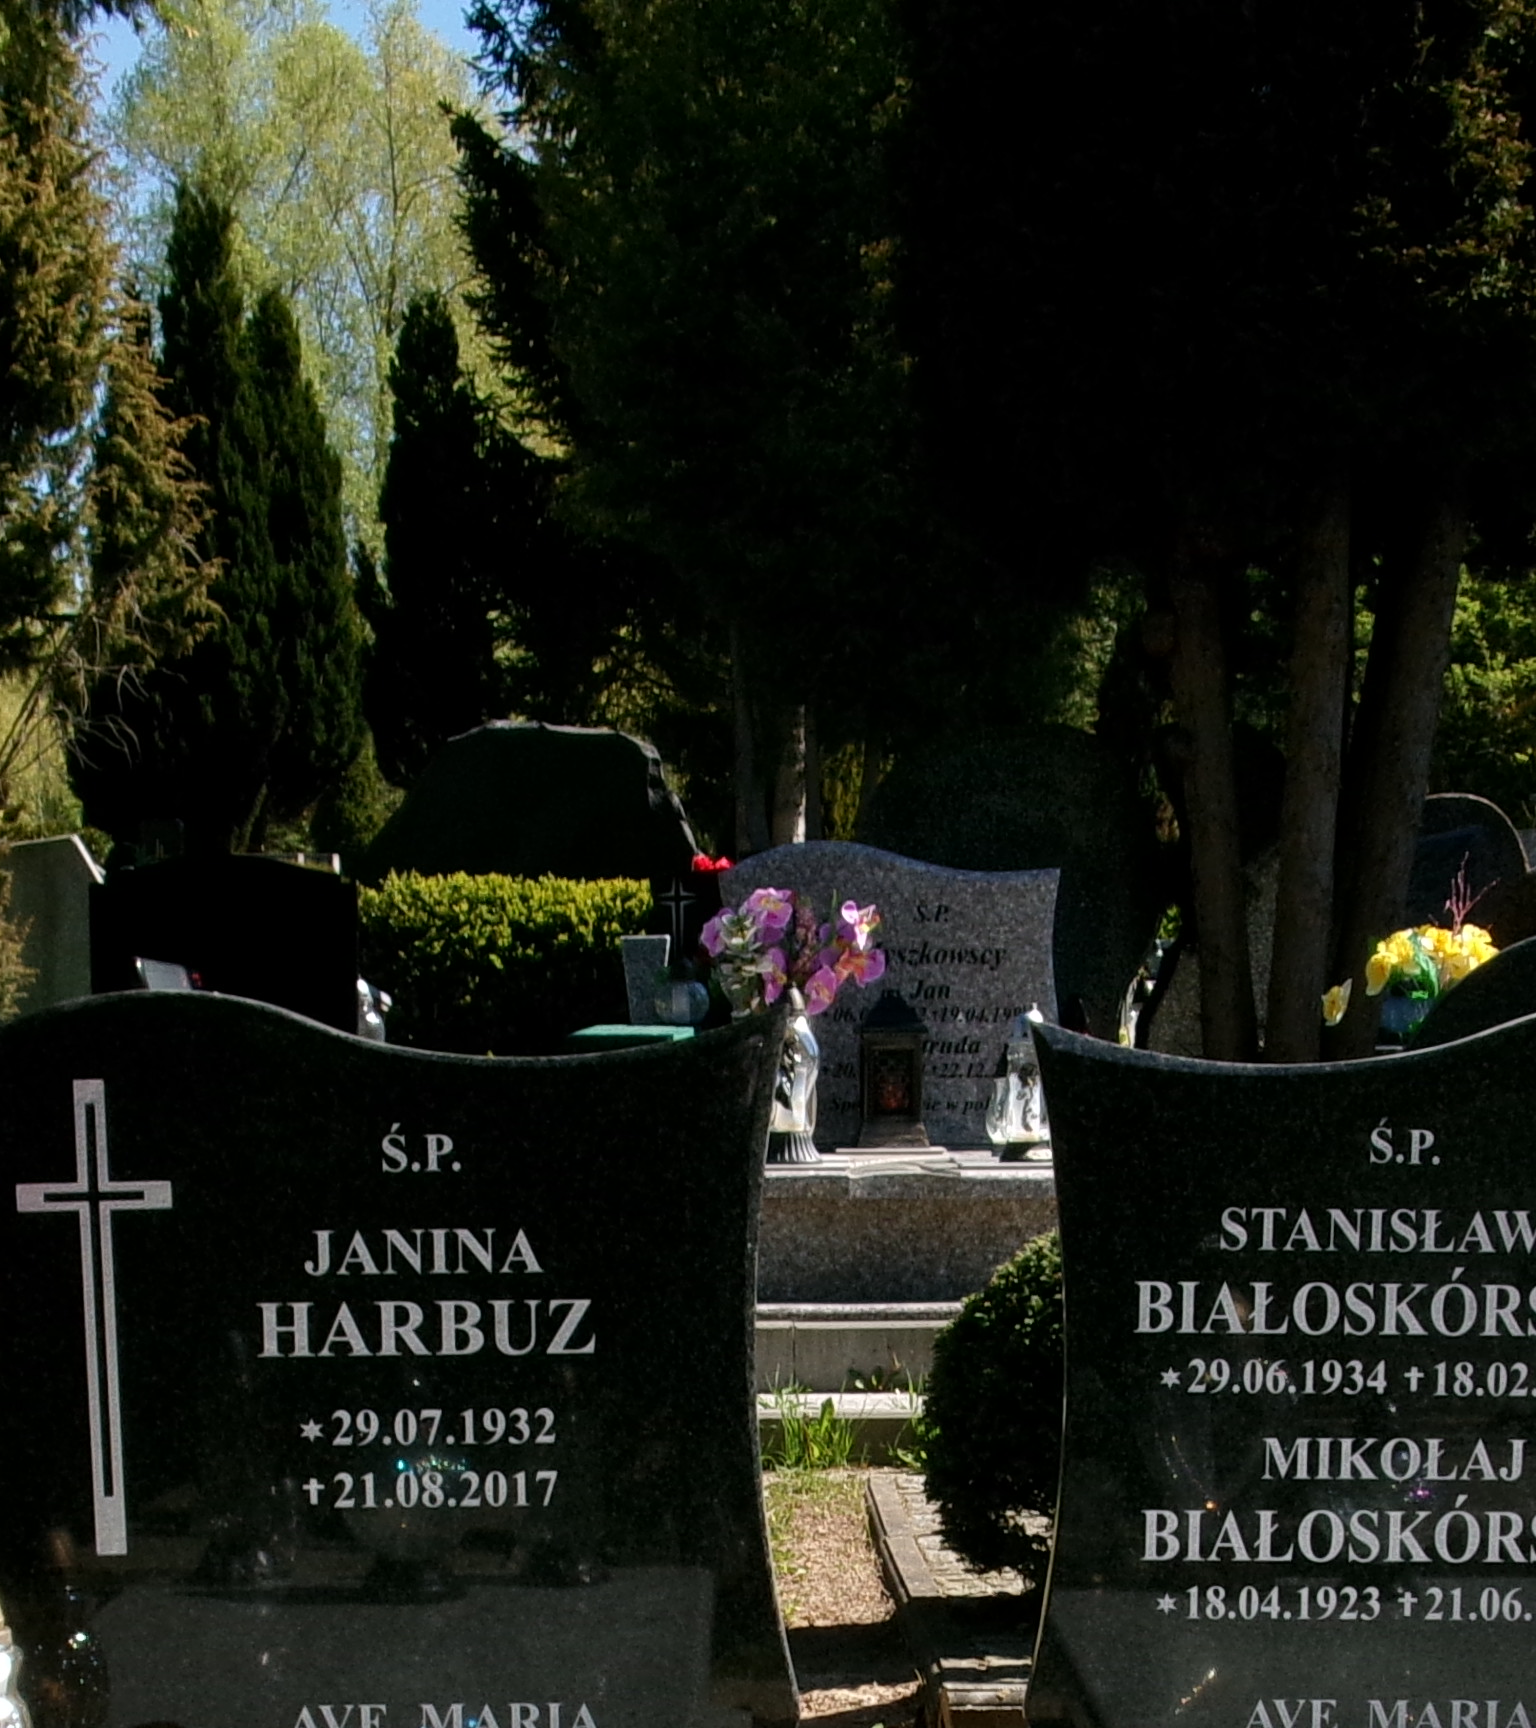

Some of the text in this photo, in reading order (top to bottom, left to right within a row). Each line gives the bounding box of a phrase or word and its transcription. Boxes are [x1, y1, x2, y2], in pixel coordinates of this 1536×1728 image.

[876, 941, 1008, 971] yszkowscy
[910, 979, 951, 1000] Jan
[381, 1122, 462, 1173] Ś.P.
[1369, 1117, 1441, 1166] Ś.P.
[303, 1228, 543, 1277] JANINA
[257, 1298, 597, 1359] HARBUZ
[1186, 1357, 1388, 1396] 29.06.1934
[330, 1407, 557, 1447] 29.07.1932
[1261, 1436, 1527, 1483] MIKOŁAJ
[332, 1469, 559, 1509] 21.08.2017
[1184, 1584, 1382, 1622] 18.04.1923
